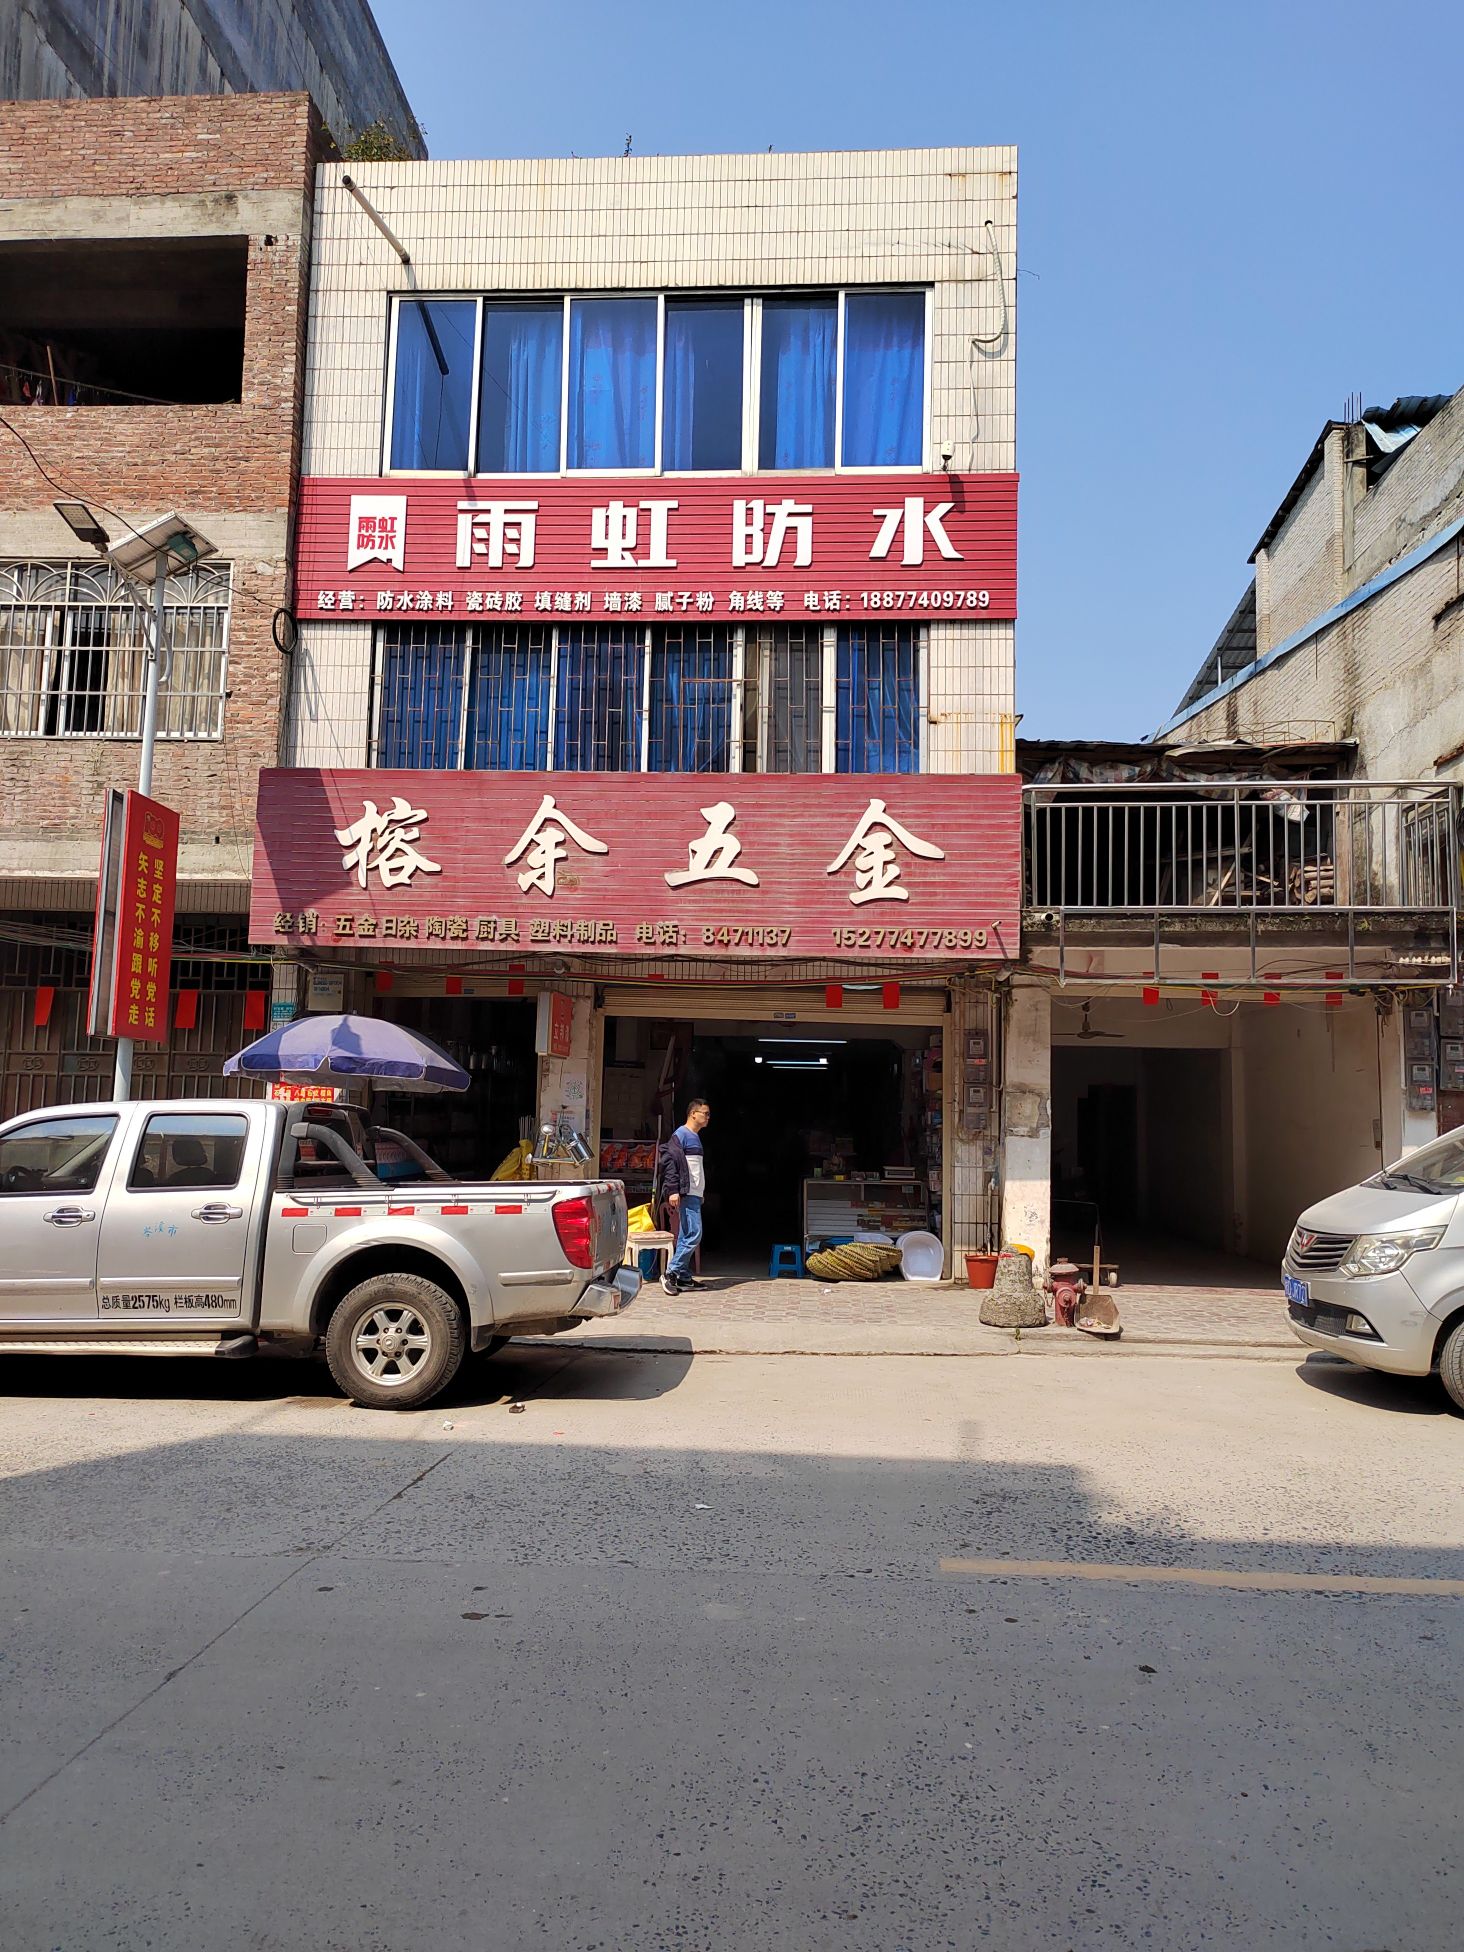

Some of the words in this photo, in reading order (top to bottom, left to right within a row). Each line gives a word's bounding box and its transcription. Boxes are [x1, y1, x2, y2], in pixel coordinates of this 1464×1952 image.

[358, 516, 397, 533] 雨虹
[456, 497, 964, 568] 雨虹防水
[356, 533, 396, 550] 防水
[377, 590, 453, 611] 防水涂料
[466, 591, 523, 612] 瓷砖胶
[534, 591, 591, 611] 填缝剂
[604, 591, 643, 611] 墙漆
[655, 591, 715, 611] 腻子粉
[728, 590, 785, 611] 角线等
[860, 590, 990, 609] 18877409789
[128, 851, 149, 1026] 矢志不渝跟党走
[144, 858, 164, 1028] 坚定不移听党话
[334, 913, 419, 938] 五金日杂
[426, 915, 468, 940] 陶瓷
[476, 917, 520, 942] 厨具
[530, 919, 618, 943] 塑料制品
[702, 926, 792, 945] 8471137
[832, 927, 988, 948] 15277477899
[101, 1294, 170, 1312] 总质量2575kg
[174, 1294, 237, 1310] 栏板高480mm
